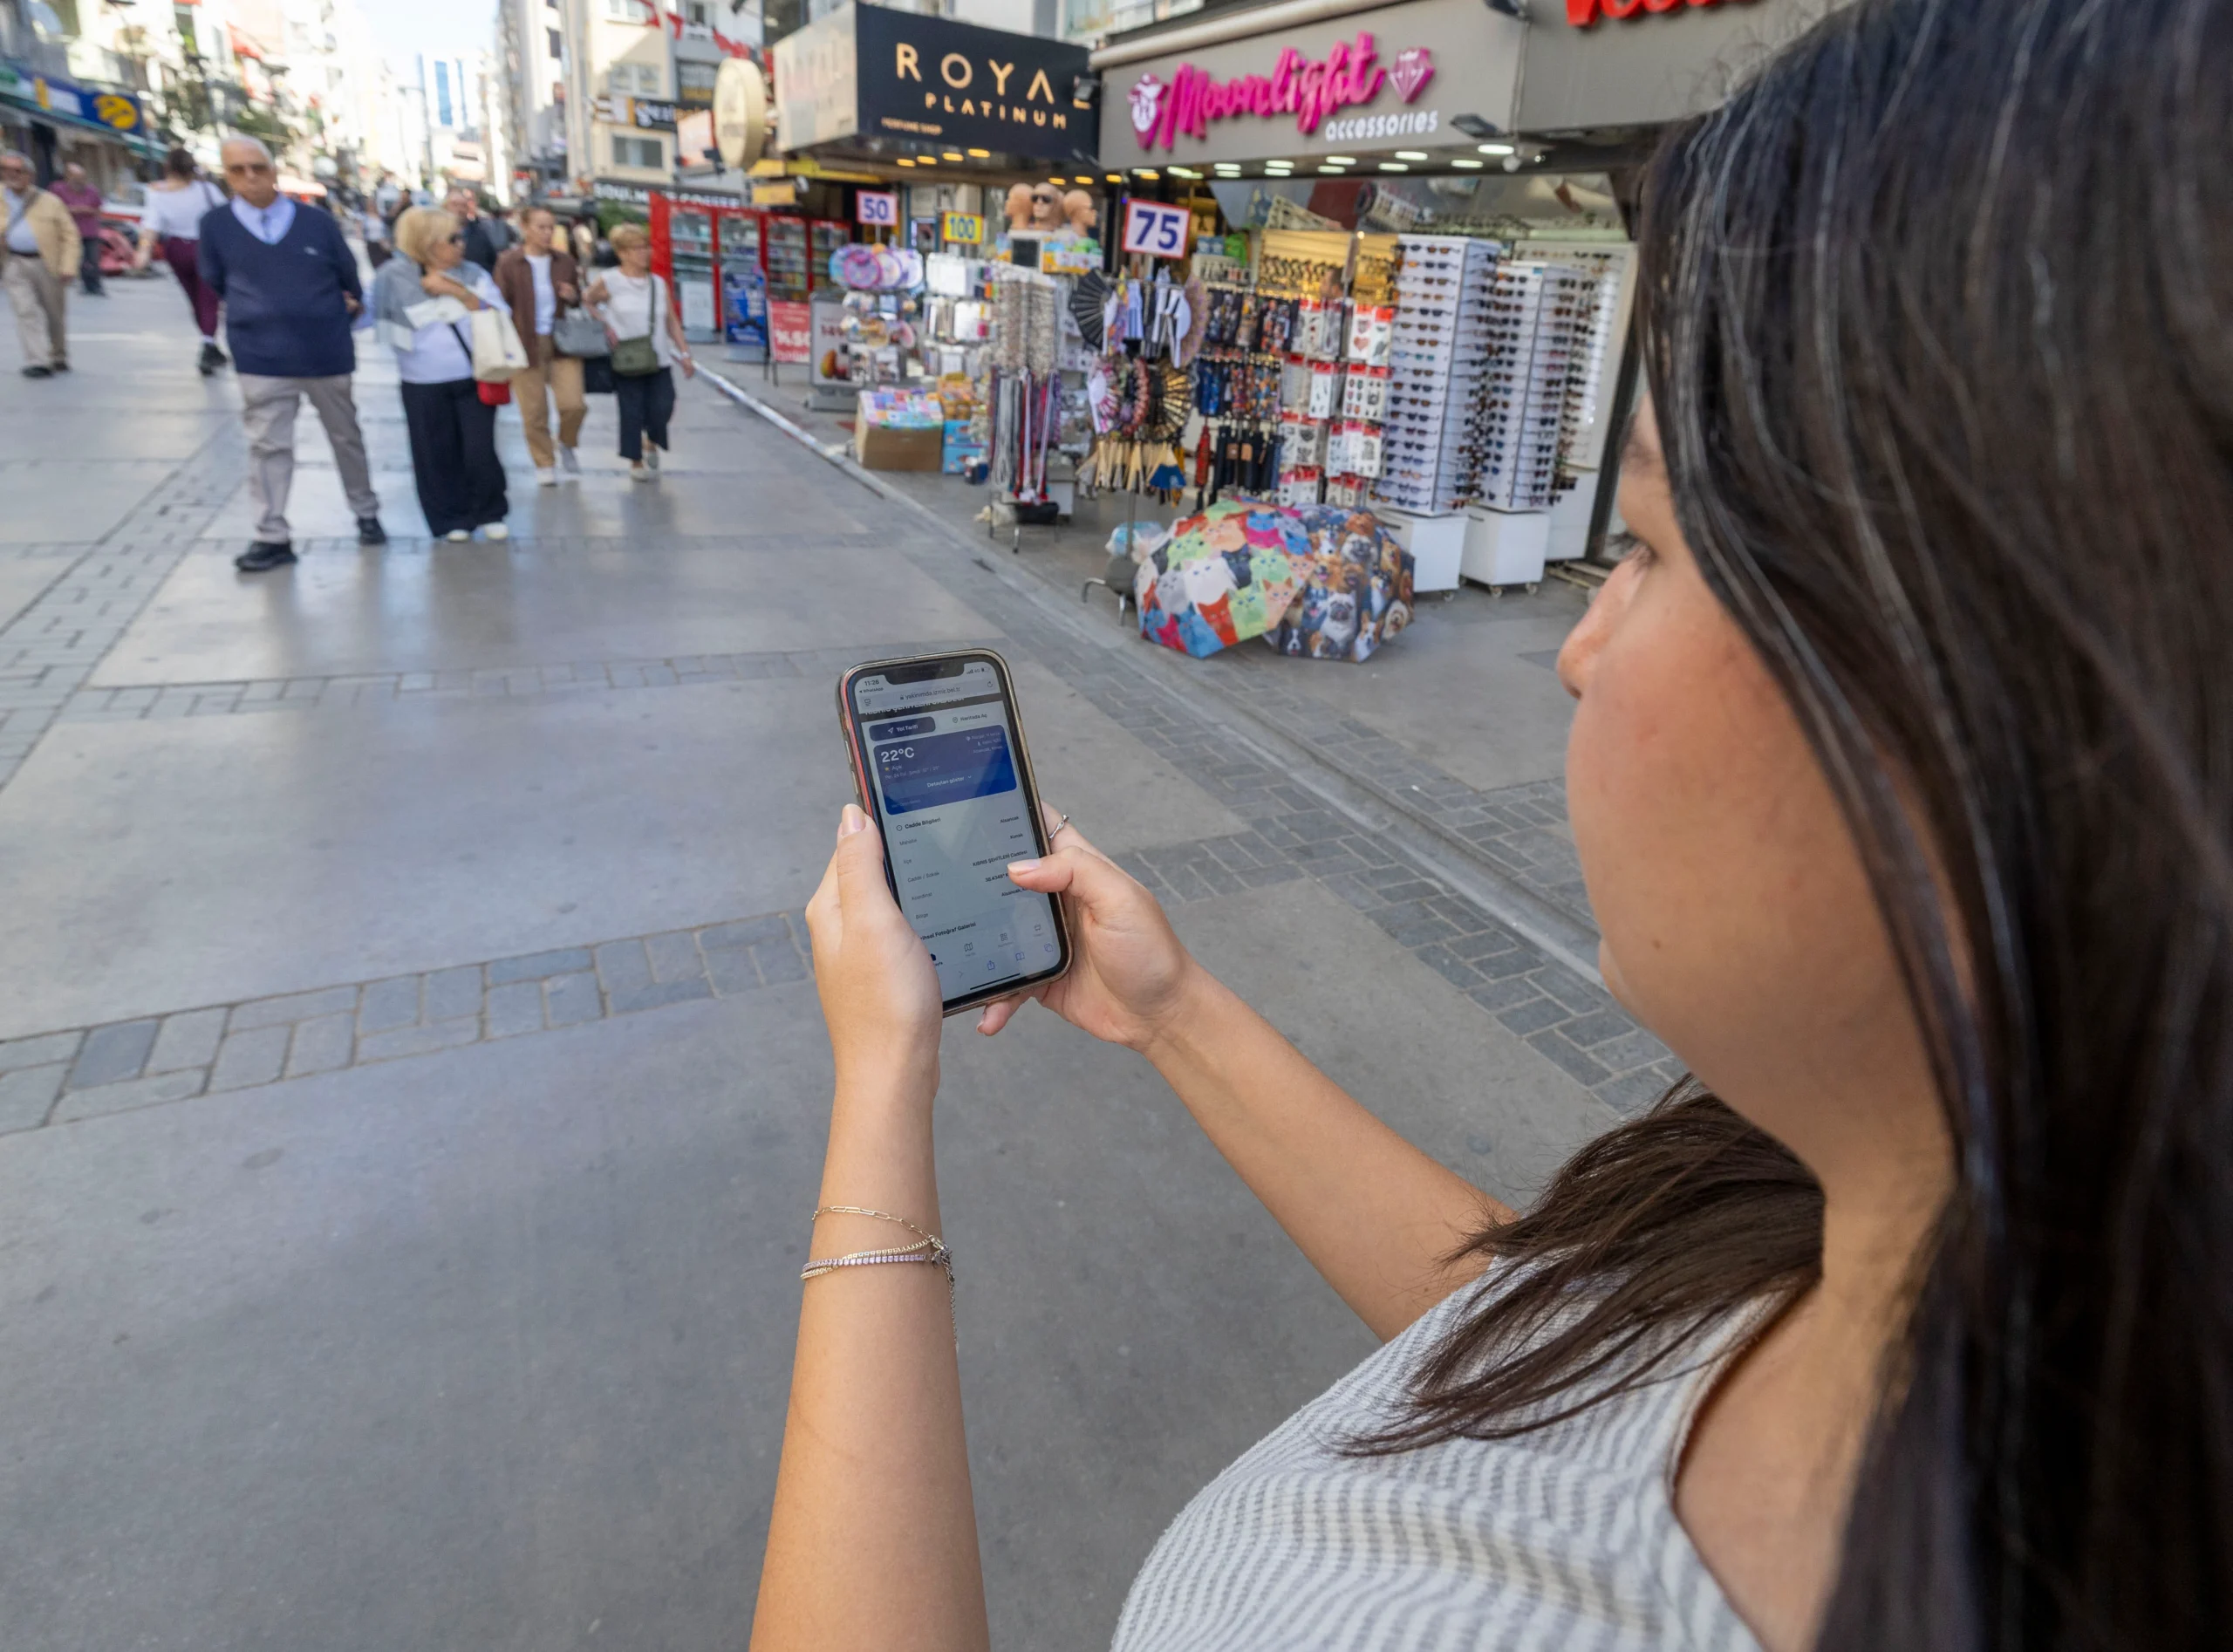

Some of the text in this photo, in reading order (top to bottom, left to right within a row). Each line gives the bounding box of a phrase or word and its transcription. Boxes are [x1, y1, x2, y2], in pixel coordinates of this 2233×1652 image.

[1159, 30, 1388, 151] Moonlight
[925, 92, 1067, 129] PLATINUM
[1325, 110, 1438, 142] accessories
[863, 199, 889, 220] 50
[949, 217, 974, 240] 100
[1136, 209, 1180, 250] 75
[880, 747, 915, 763] 22°C
[922, 817, 941, 827] Bilgileri
[1000, 816, 1019, 824] Alsancak
[935, 926, 957, 937] Fotoğraf
[957, 922, 976, 932] Galerisi
